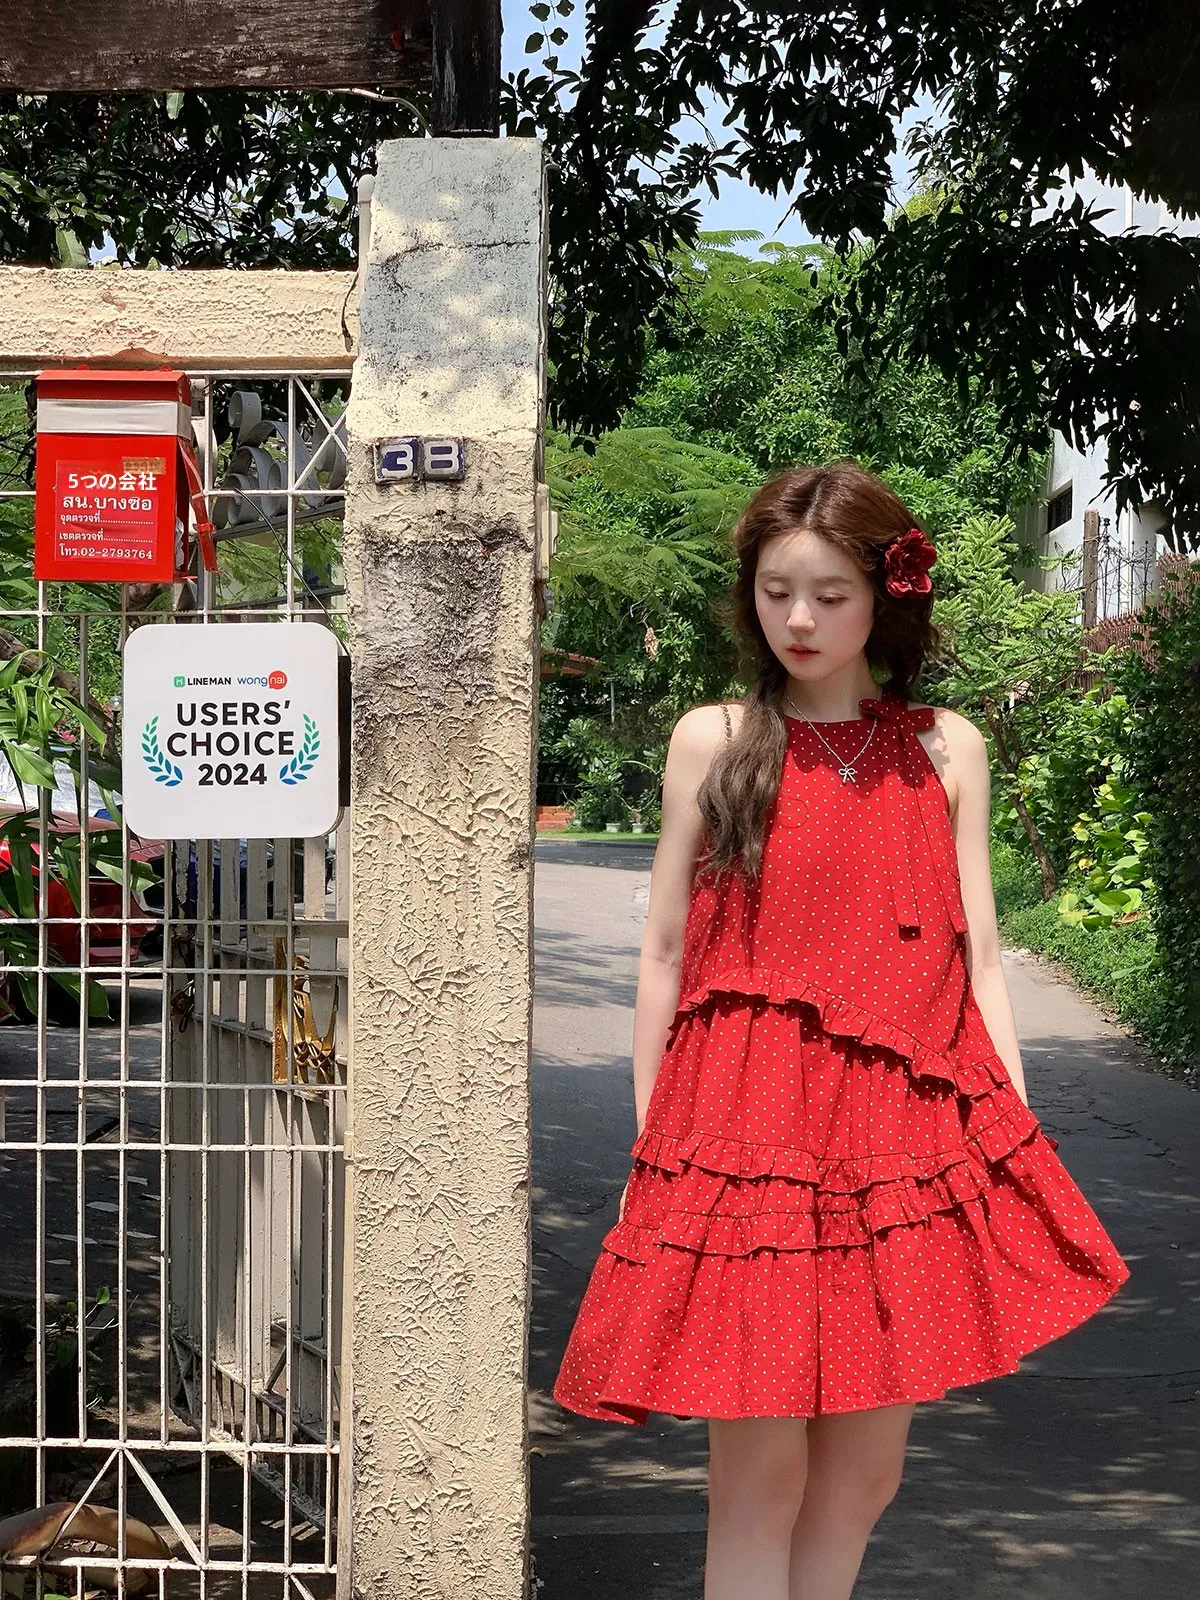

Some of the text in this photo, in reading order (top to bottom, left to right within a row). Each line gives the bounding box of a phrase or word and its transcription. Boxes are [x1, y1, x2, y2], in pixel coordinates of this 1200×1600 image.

[381, 441, 459, 477] 38
[68, 472, 158, 491] 5つの会社
[177, 700, 291, 726] USERS'
[166, 731, 295, 757] CHOICE
[197, 763, 268, 786] 2024
